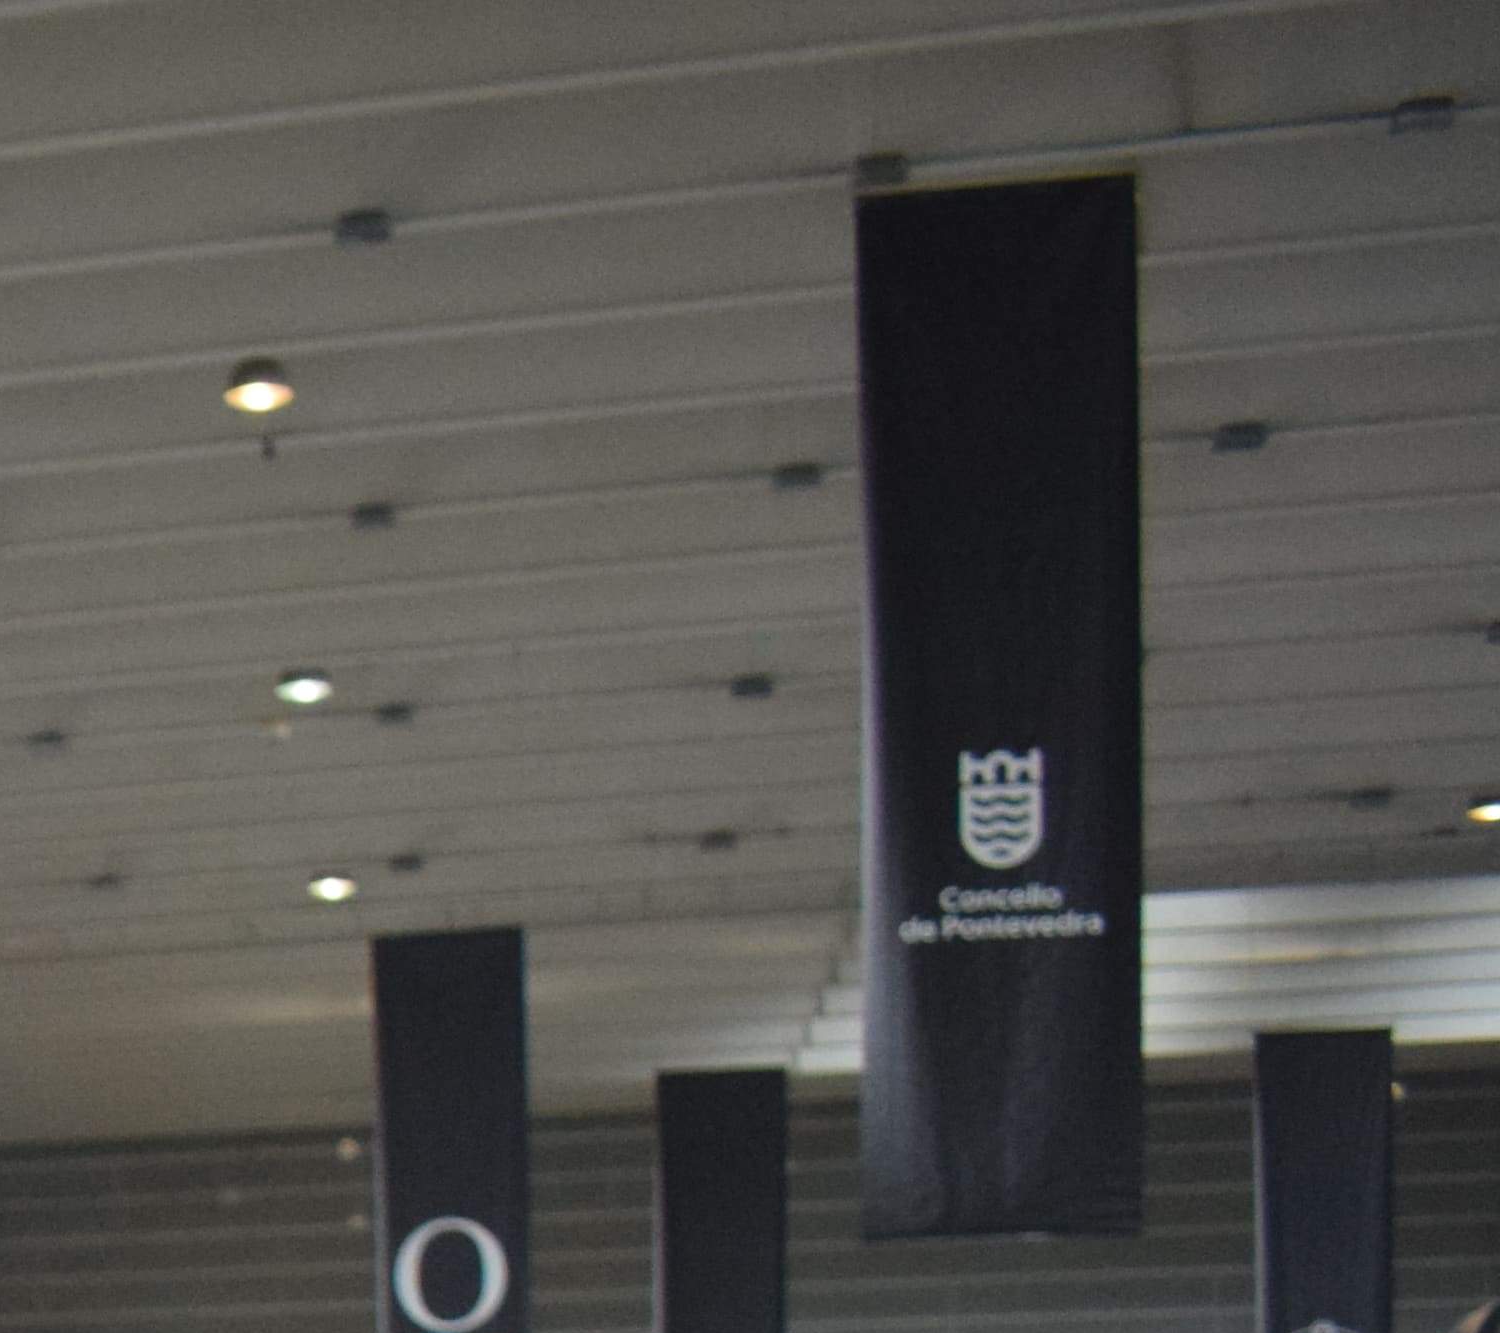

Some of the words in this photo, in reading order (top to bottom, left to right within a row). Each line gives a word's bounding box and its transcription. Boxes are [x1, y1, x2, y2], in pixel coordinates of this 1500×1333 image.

[938, 883, 1065, 912] Concello
[898, 916, 938, 944] de
[941, 909, 1105, 942] Pontevedra
